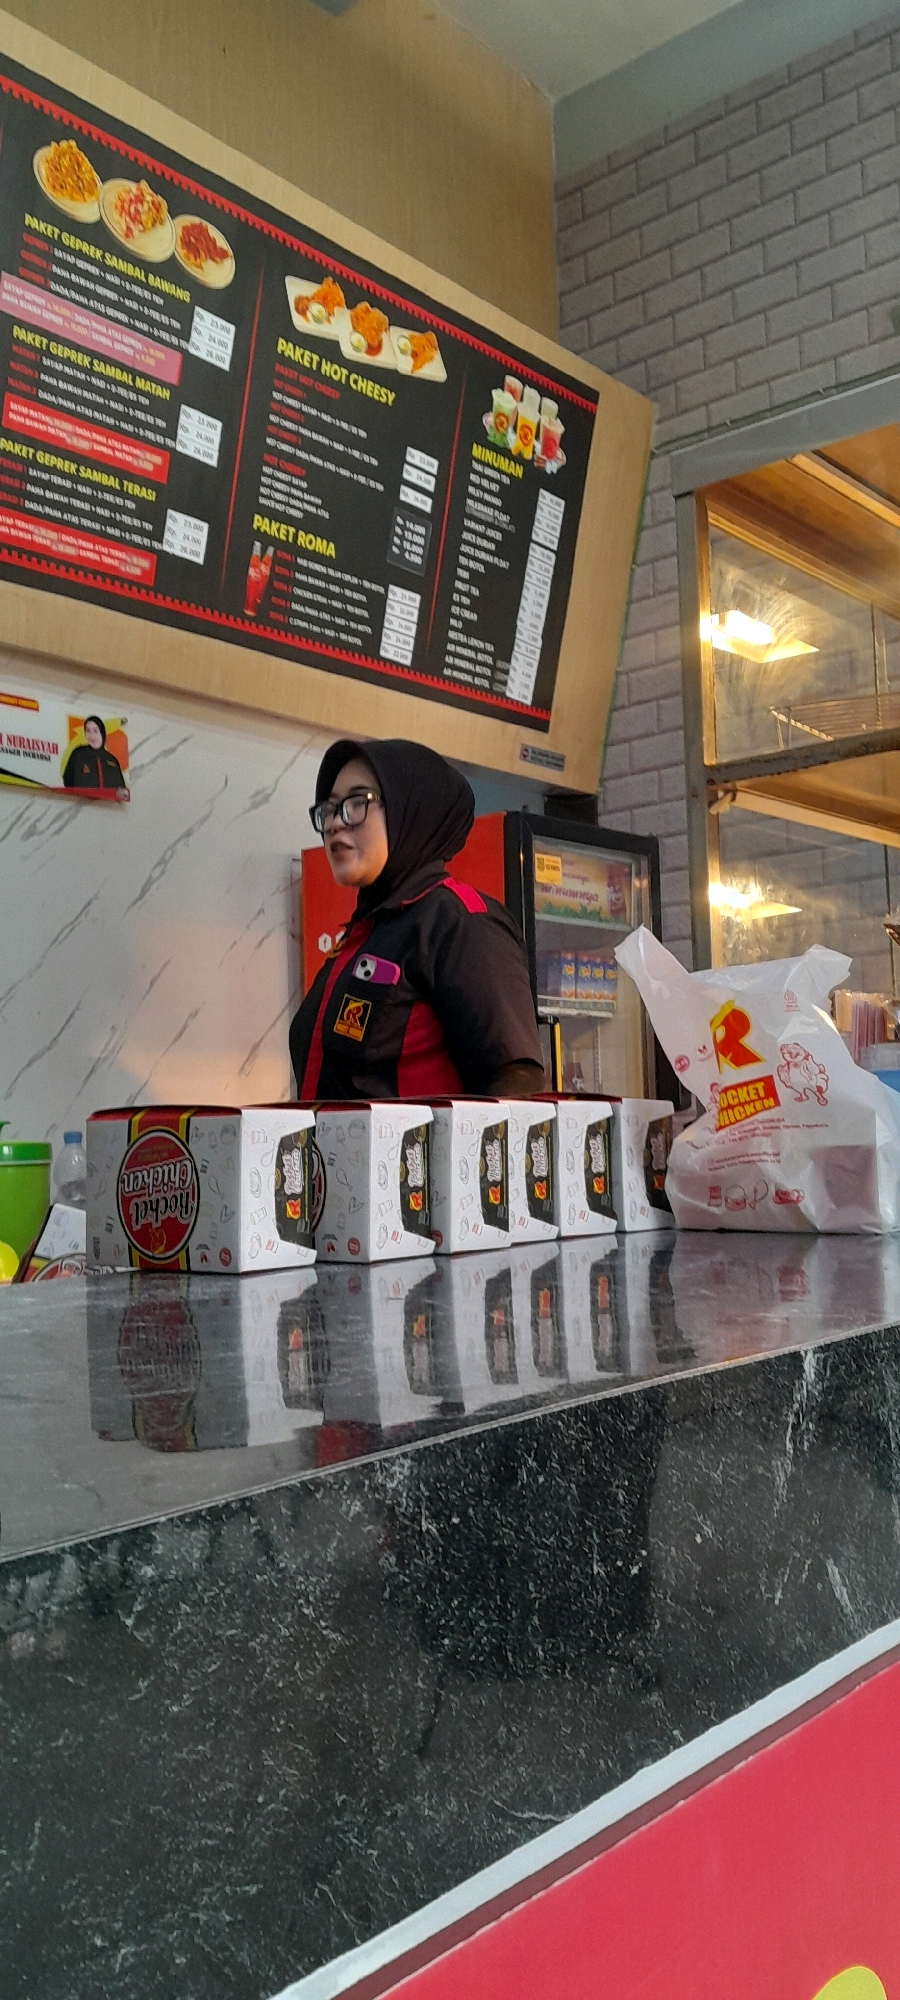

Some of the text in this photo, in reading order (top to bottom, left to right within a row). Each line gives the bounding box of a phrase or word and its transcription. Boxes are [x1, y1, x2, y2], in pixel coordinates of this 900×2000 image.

[24, 213, 60, 242] PAKET
[61, 231, 104, 262] GEPREK
[104, 252, 147, 283] SAMBAL
[148, 273, 191, 304] BAWANG
[12, 325, 49, 351] PAKET
[49, 341, 92, 369] GEPREK
[92, 359, 134, 387] SAMBAL
[135, 377, 171, 402] MATAH
[277, 337, 396, 409] PAKET HOT CHEESY
[0, 437, 35, 461] PAKET
[35, 450, 78, 476] GEPREK
[79, 466, 121, 491] SAMBAL
[122, 481, 156, 503] TERASI
[472, 442, 524, 480] MINUMAN
[253, 514, 337, 559] PAKET ROMA
[7, 734, 59, 756] NURAISYAH
[717, 1097, 776, 1127] HICKEN
[719, 1081, 766, 1110] OCKET
[122, 1158, 194, 1194] Chicken
[133, 1189, 195, 1228] Rocket
